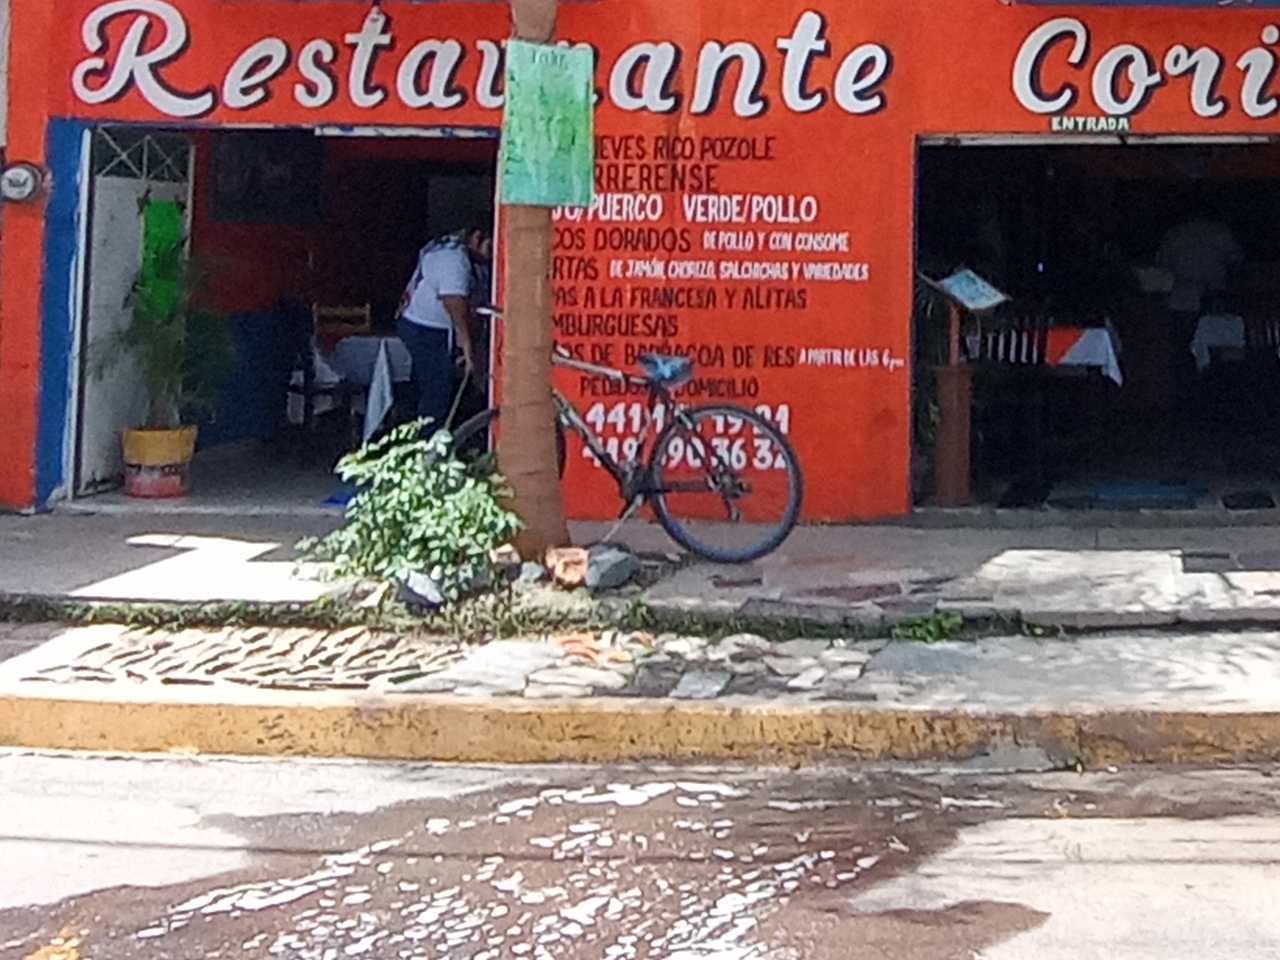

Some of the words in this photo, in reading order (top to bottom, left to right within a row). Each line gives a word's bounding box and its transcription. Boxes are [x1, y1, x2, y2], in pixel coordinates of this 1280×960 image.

[1051, 116, 1129, 131] ENTRADA
[653, 136, 695, 161] RICO
[701, 137, 776, 161] POZOLE
[594, 164, 719, 192] RRERENSE
[683, 194, 817, 223] VERDE/POLLO
[594, 227, 691, 253] DORADOS
[718, 230, 754, 251] POLLO
[756, 231, 765, 251] Y
[791, 262, 801, 281] Y
[583, 286, 595, 309] A
[601, 287, 623, 308] LA
[630, 288, 716, 309] FRANCESA
[724, 289, 737, 309] Y
[742, 287, 806, 309] ALITAS
[552, 314, 678, 337] MBURGUESAS
[733, 345, 757, 367] DE
[763, 345, 795, 368] RES
[585, 403, 643, 434] 441
